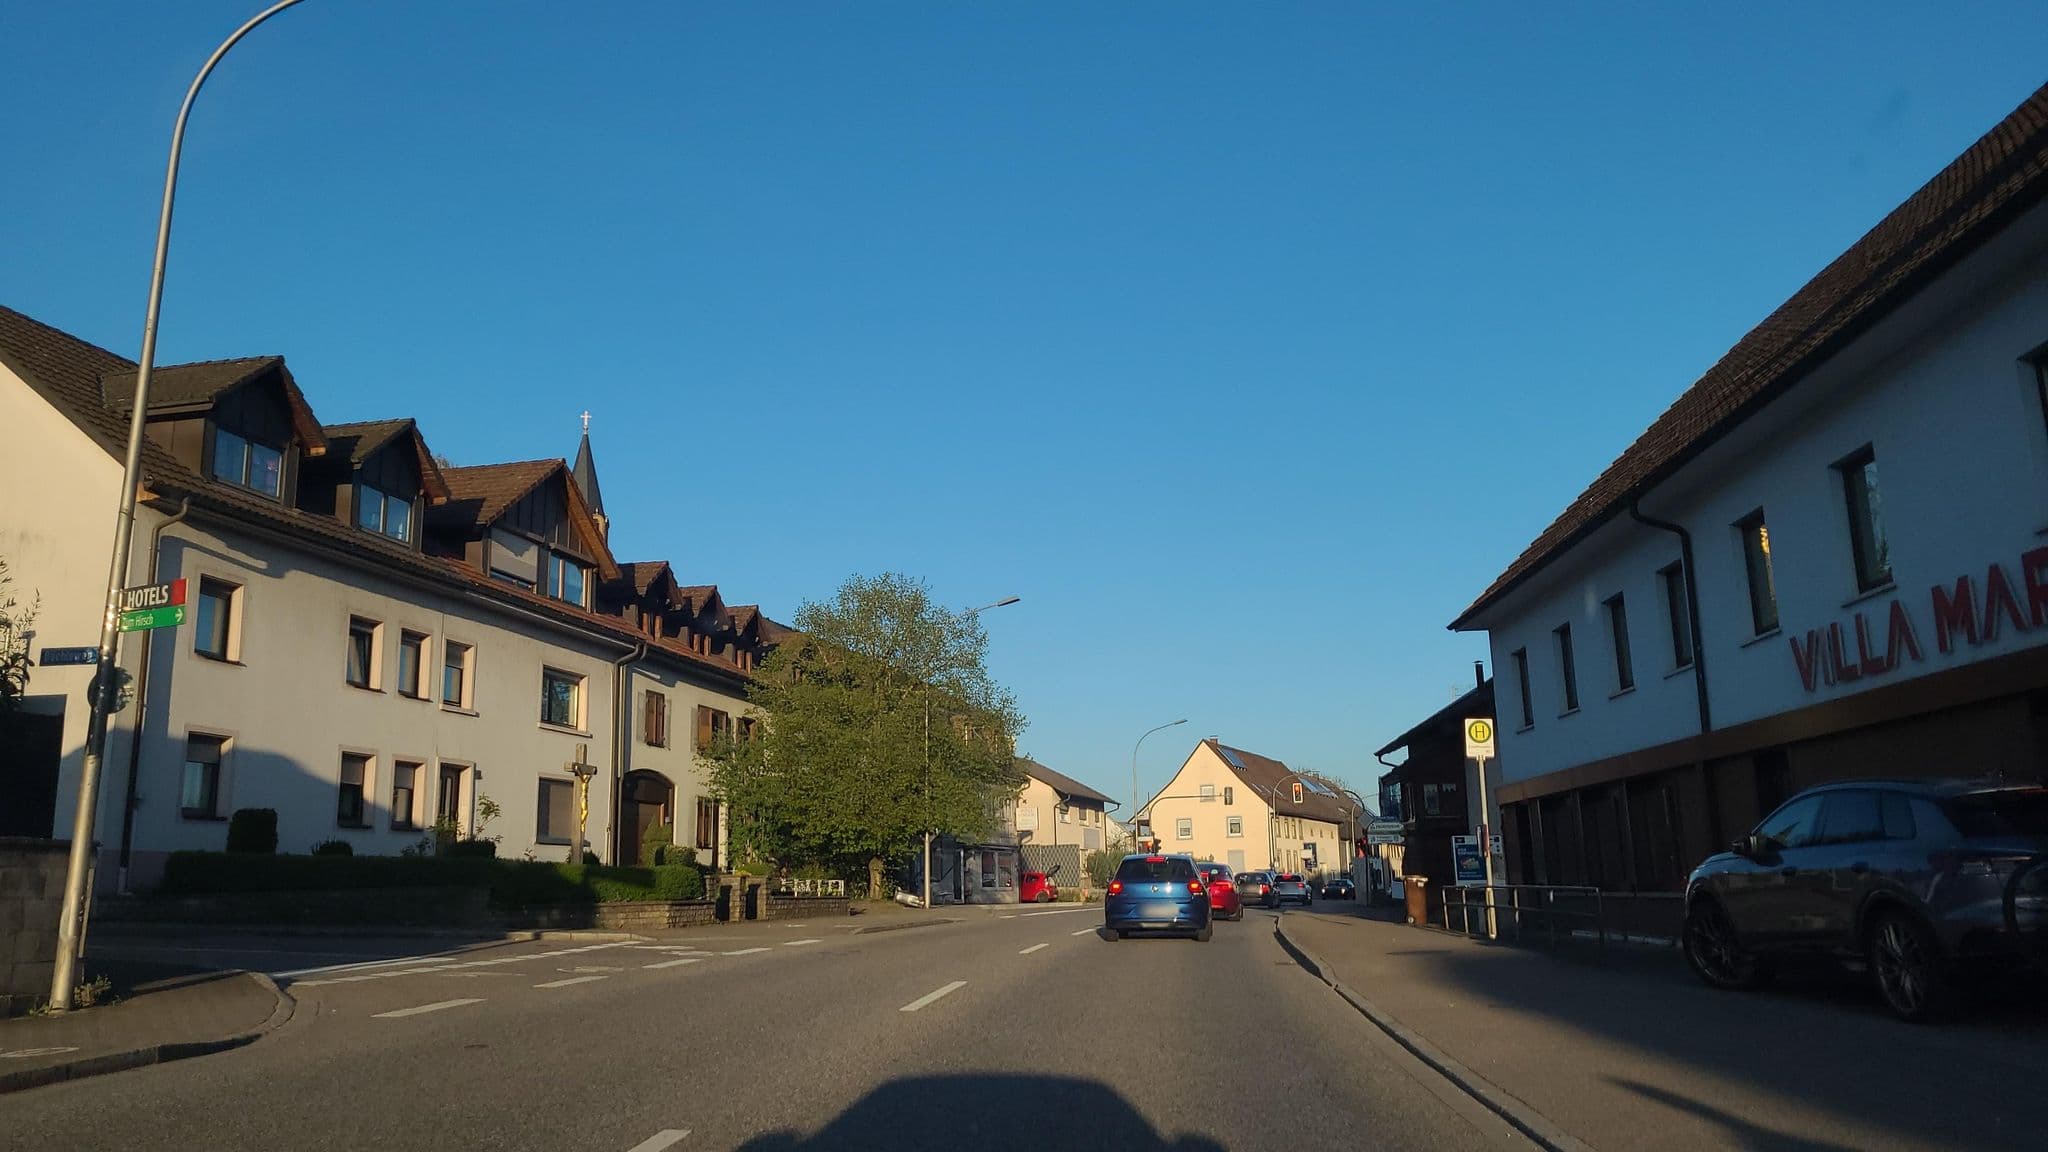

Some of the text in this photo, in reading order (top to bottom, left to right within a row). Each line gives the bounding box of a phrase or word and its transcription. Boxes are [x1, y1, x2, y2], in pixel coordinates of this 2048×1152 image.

[127, 585, 169, 608] HOTELS
[135, 613, 154, 626] Hirsch
[1789, 599, 1922, 692] VILLA
[1475, 725, 1485, 739] H
